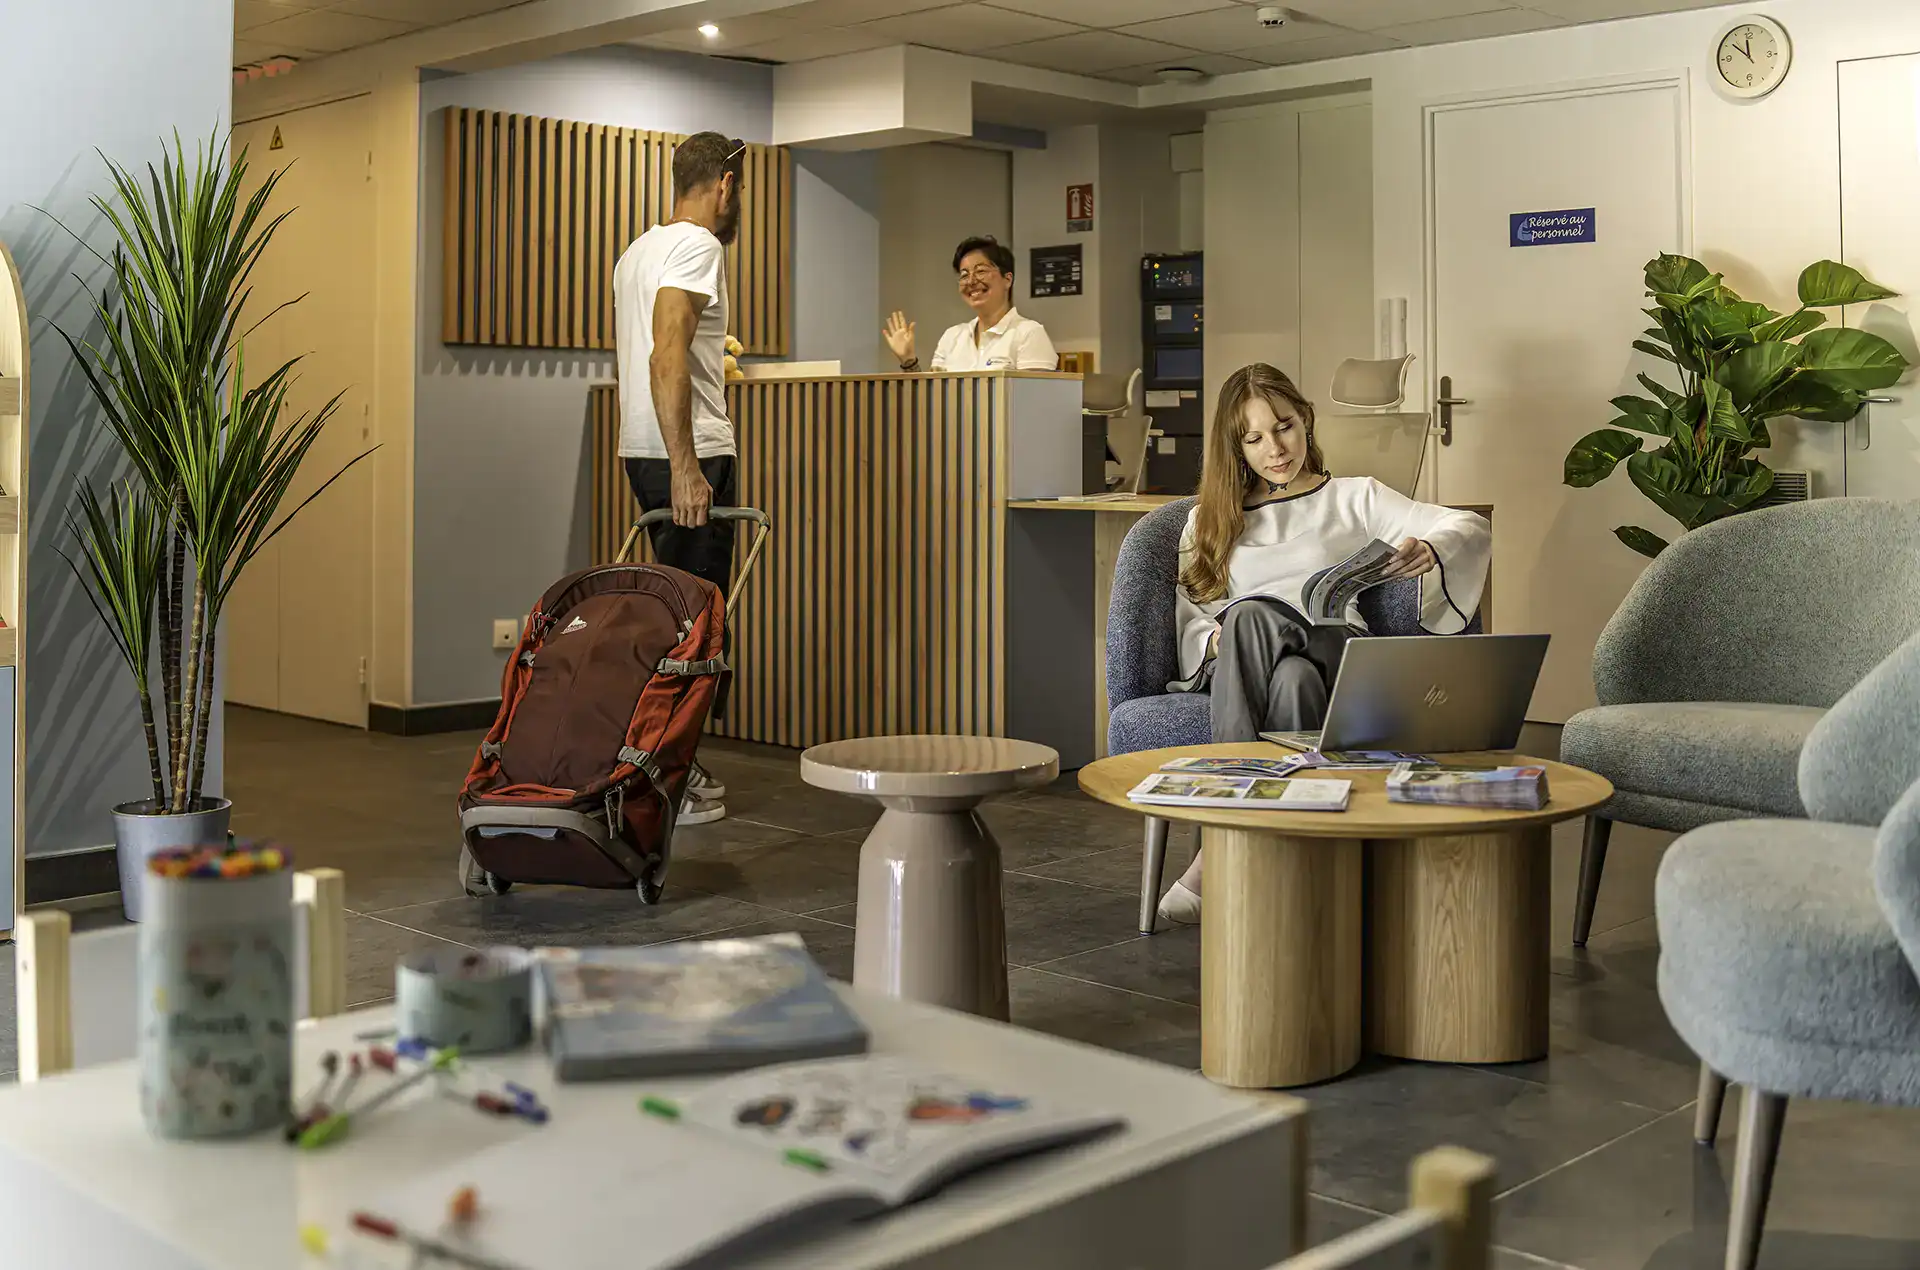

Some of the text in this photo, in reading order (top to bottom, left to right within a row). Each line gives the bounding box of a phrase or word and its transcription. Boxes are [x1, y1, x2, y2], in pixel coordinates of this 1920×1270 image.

[1725, 55, 1733, 63] 9
[1766, 50, 1773, 58] 3
[1746, 73, 1753, 81] 6
[1528, 214, 1587, 228] Réservé au
[1531, 225, 1585, 242] personnel
[1424, 684, 1448, 708] hp
